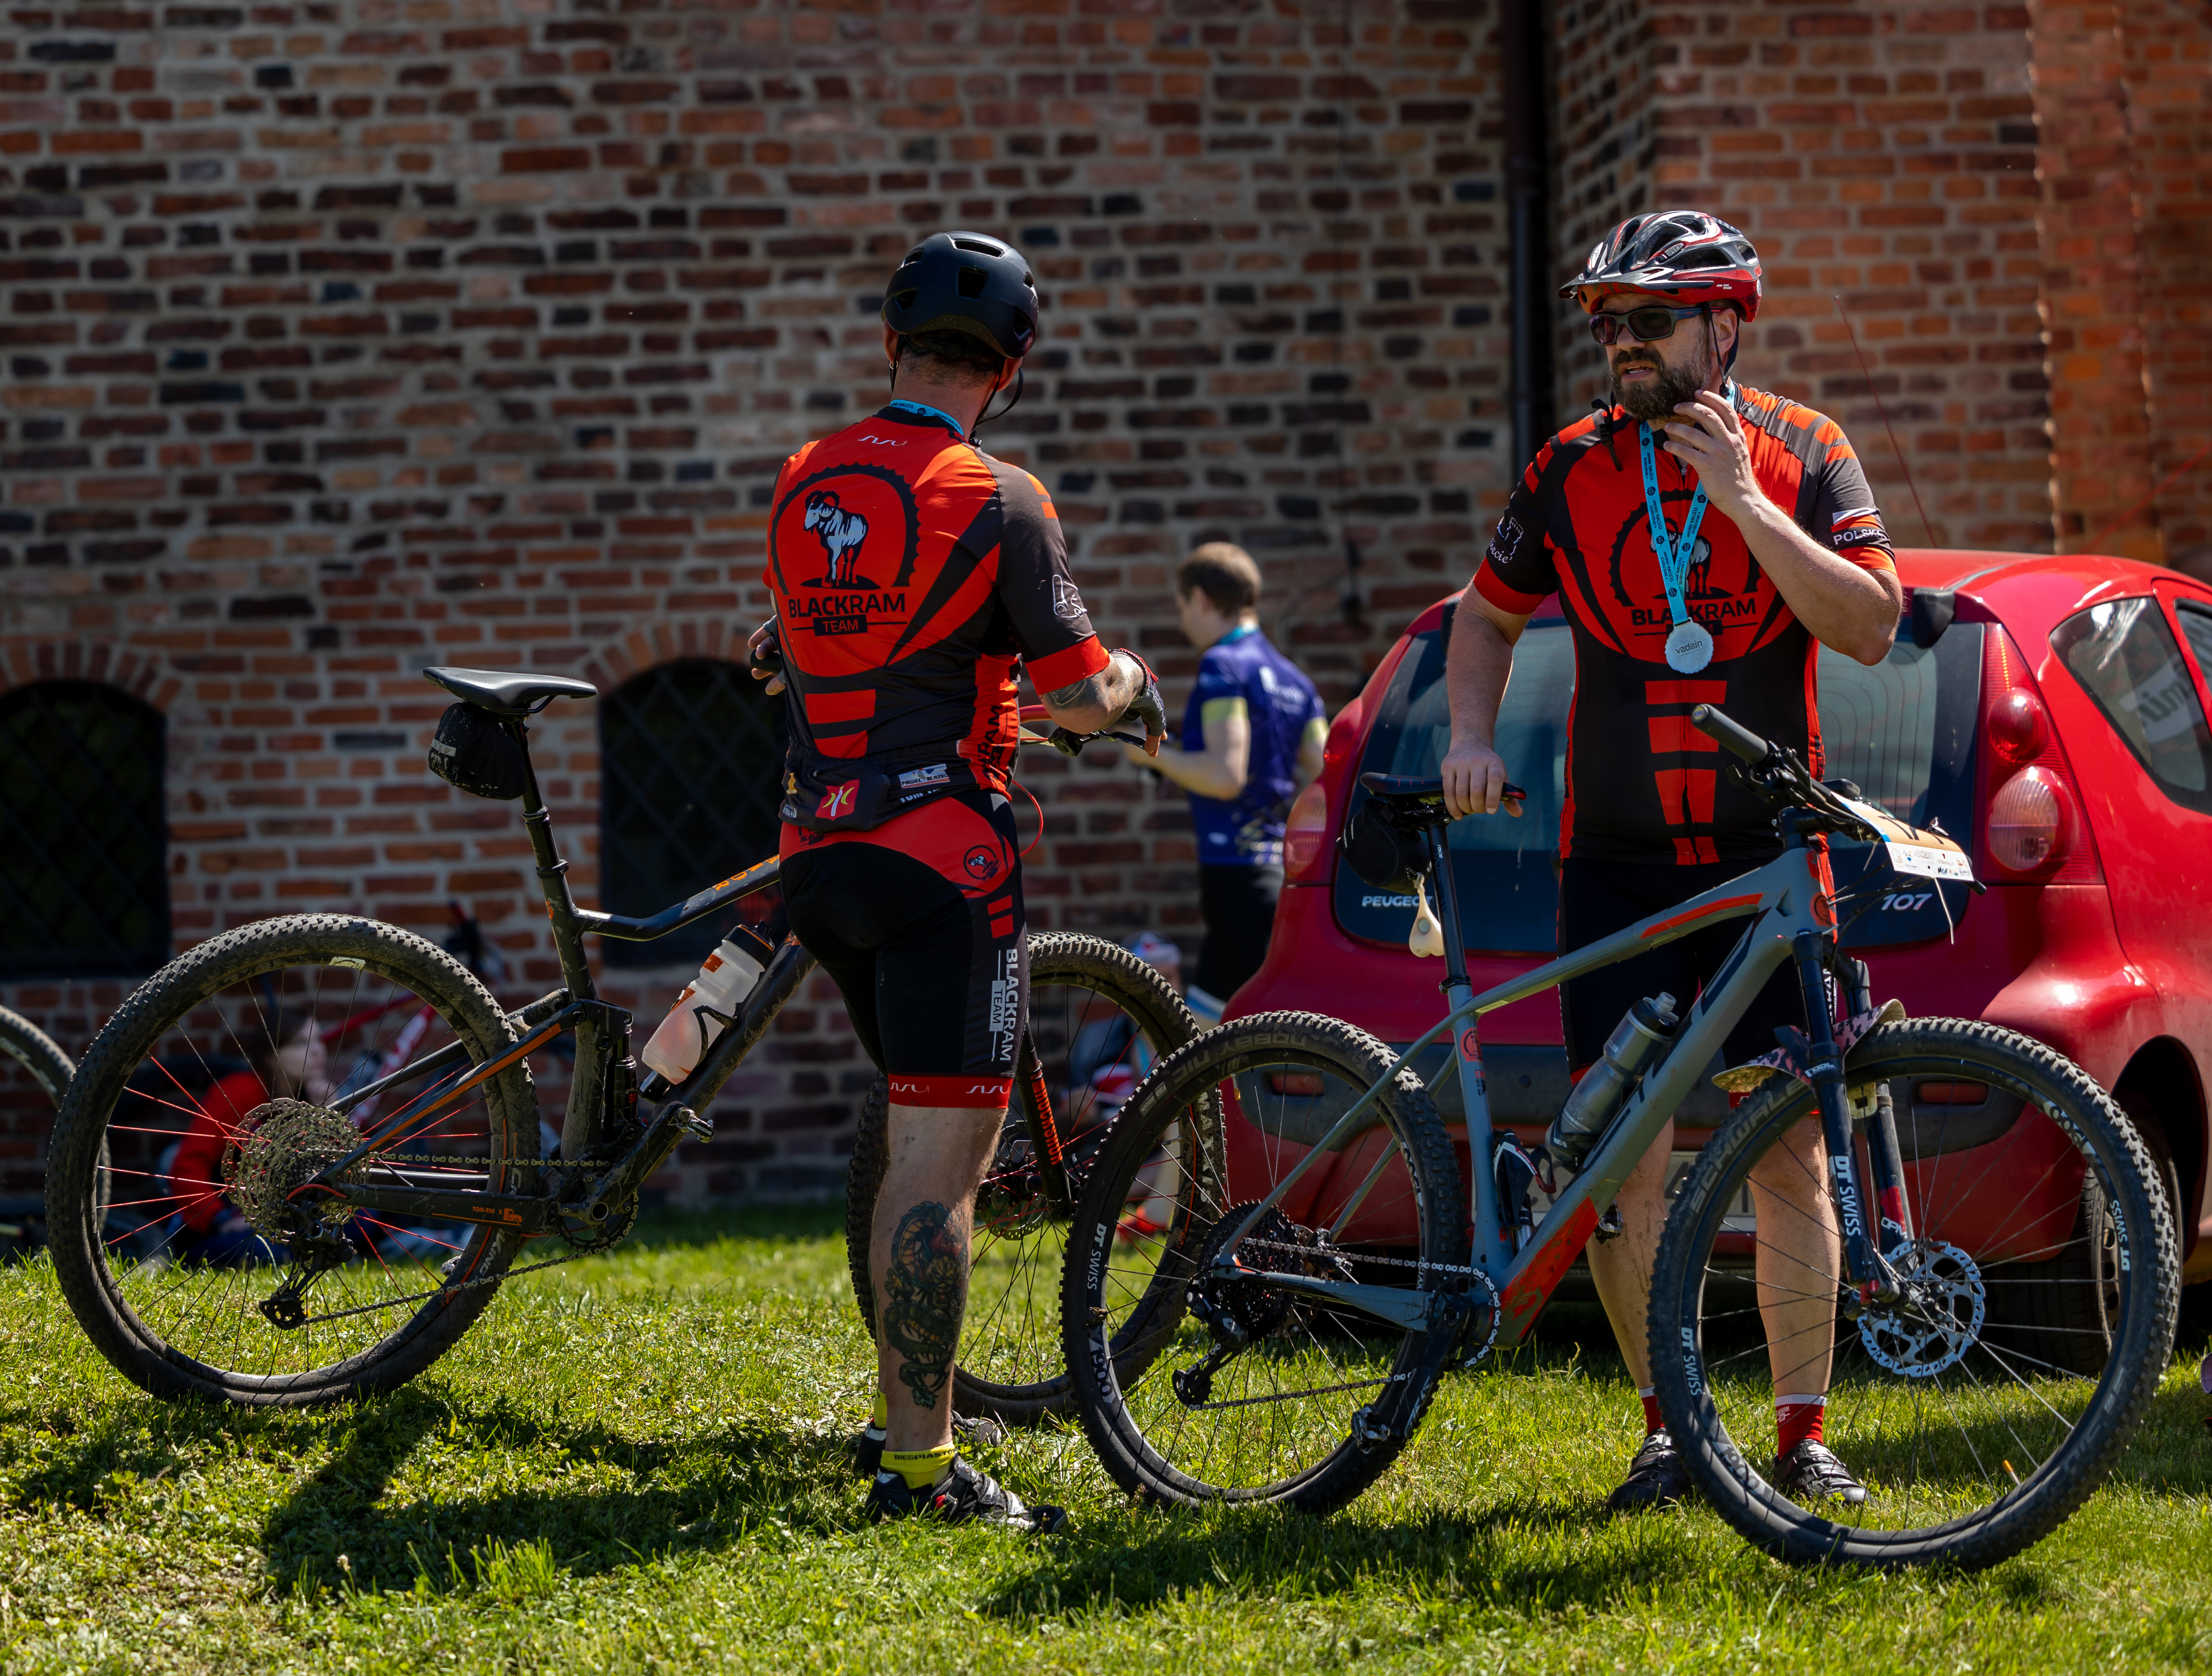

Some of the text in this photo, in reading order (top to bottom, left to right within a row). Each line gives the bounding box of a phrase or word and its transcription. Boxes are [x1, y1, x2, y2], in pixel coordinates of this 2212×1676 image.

[1666, 243, 1682, 255] uvex
[788, 593, 906, 619] BLACKRAM
[1631, 598, 1756, 626] BLAKRAM
[822, 619, 859, 633] TEAM
[1675, 640, 1703, 654] vadain
[1881, 893, 1932, 911] 107
[992, 989, 1003, 1024] TEAM
[1000, 948, 1019, 1061] BLACKRAM
[691, 1121, 713, 1137] SHIMANO
[1693, 1078, 1805, 1214] SCHWALB
[1837, 1155, 1861, 1237] DT SWISS
[472, 1206, 502, 1215] TOM-TRAS
[2109, 1199, 2131, 1271] DT SWISS
[1087, 1223, 1107, 1290] DT SWISS
[1681, 1326, 1703, 1397] DT SWISS
